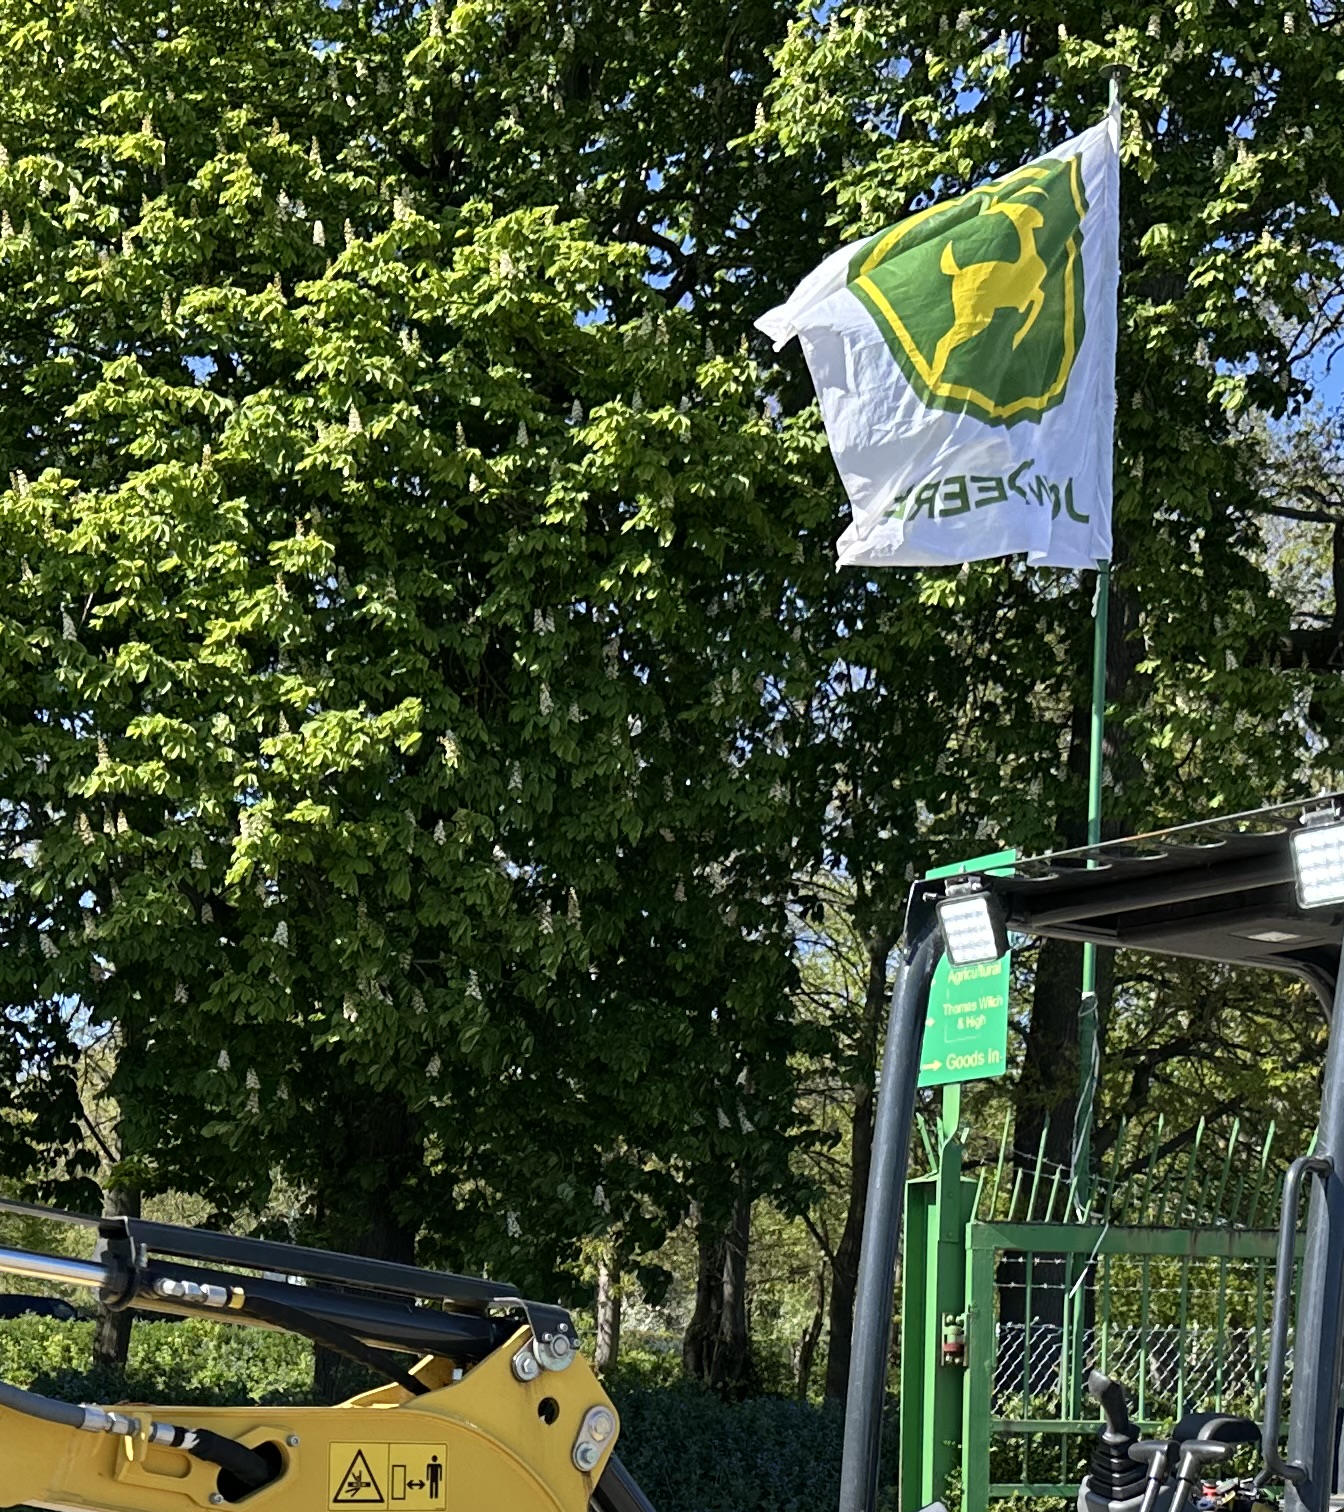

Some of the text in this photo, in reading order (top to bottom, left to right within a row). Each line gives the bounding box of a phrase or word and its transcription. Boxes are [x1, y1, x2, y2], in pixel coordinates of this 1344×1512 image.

[942, 1001, 977, 1016] Thomas
[957, 1014, 987, 1030] & High
[946, 1050, 985, 1070] Goods
